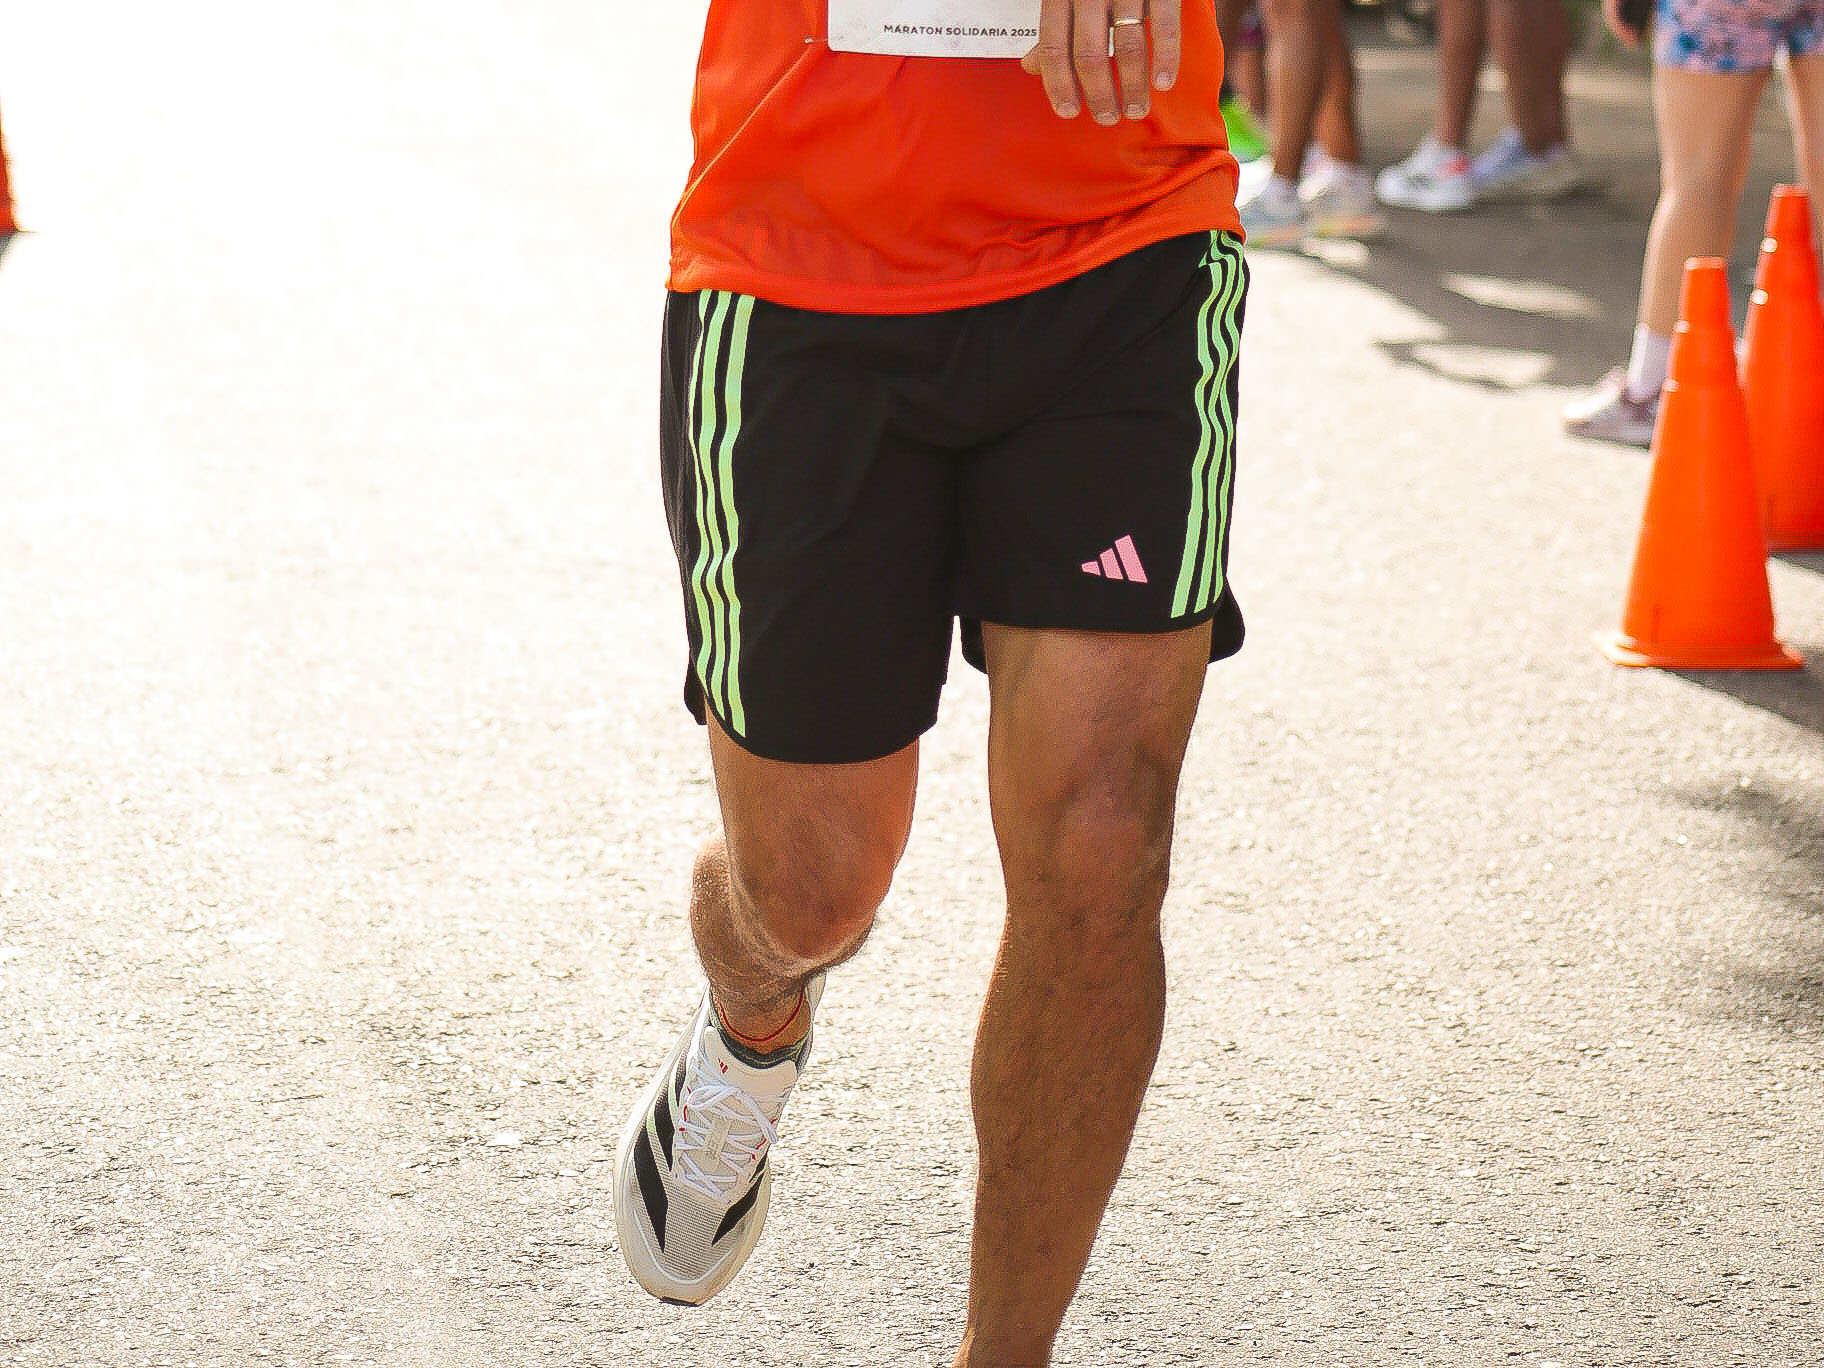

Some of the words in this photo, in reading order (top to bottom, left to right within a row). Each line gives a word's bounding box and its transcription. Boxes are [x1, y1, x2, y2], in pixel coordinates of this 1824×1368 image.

[883, 24, 944, 35] MARATON
[945, 27, 1008, 37] SOLIDARIA
[1010, 28, 1038, 37] 2025
